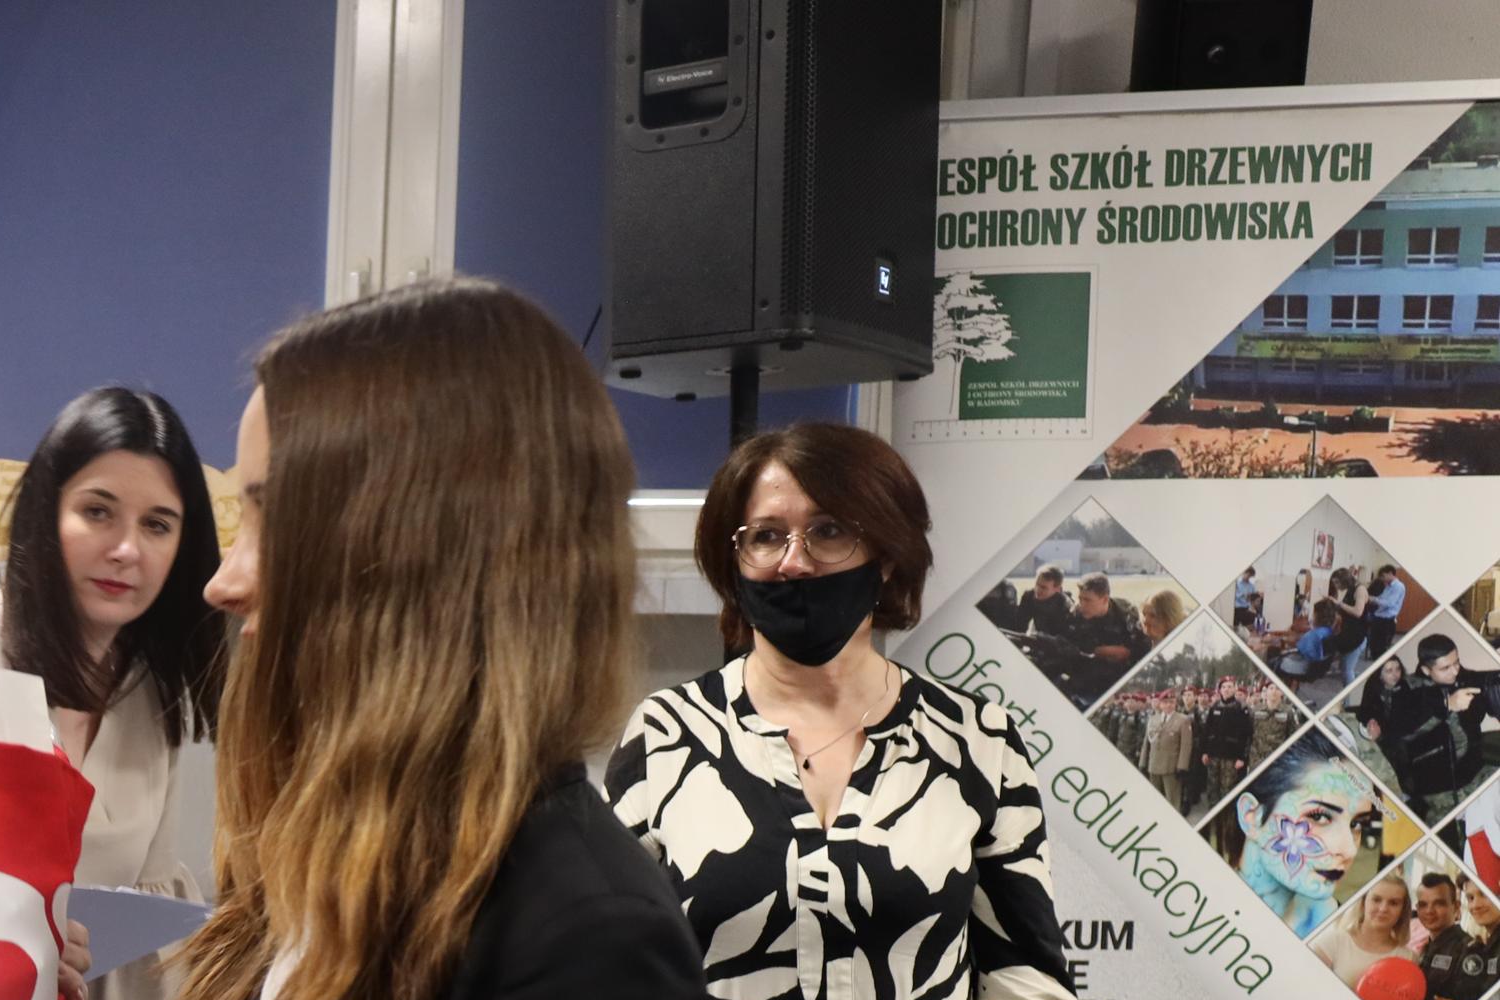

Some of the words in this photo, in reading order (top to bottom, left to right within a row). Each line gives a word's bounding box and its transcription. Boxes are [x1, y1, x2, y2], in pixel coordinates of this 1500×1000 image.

[938, 149, 1039, 196] ESPÓŁ
[1049, 145, 1154, 191] SZKÓŁ
[1164, 142, 1373, 187] DRZEWNYCH
[937, 207, 1087, 250] OCHRONY
[1097, 200, 1314, 245] ŚRODOWISKA
[1050, 765, 1273, 995] edukacyjna
